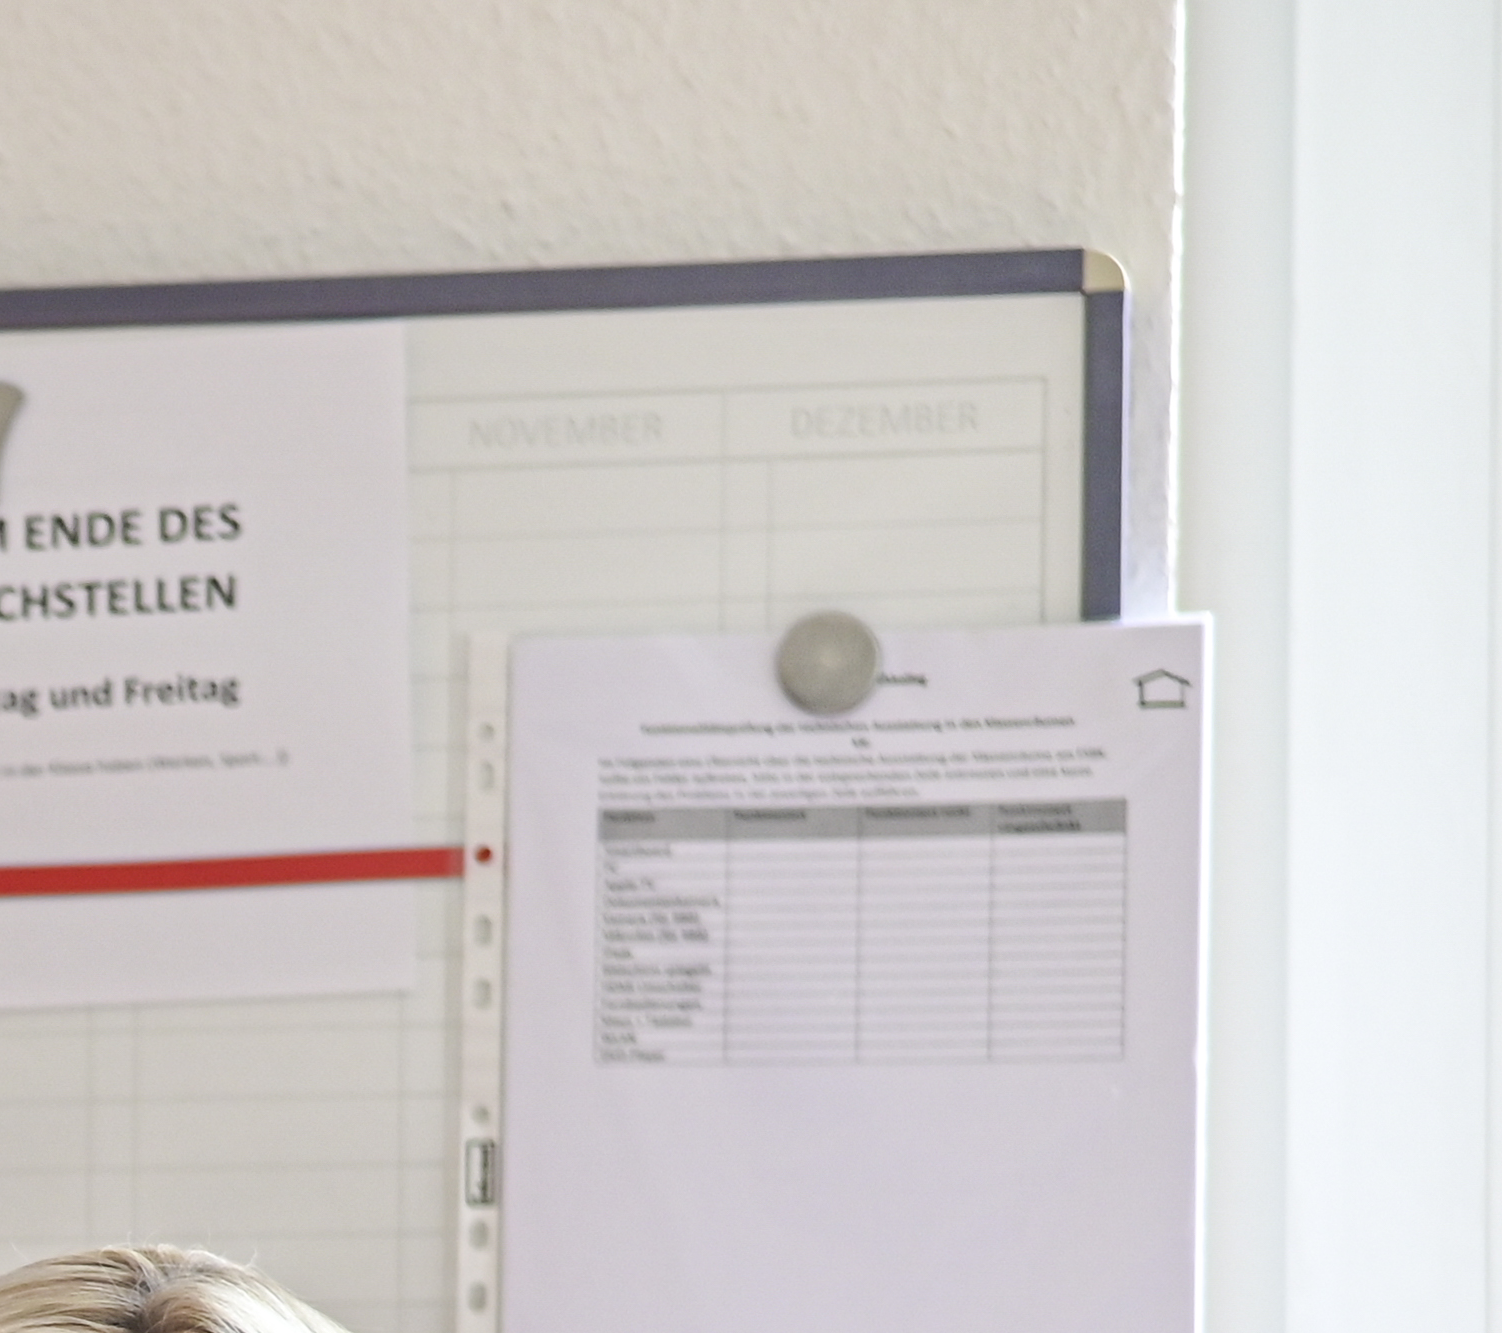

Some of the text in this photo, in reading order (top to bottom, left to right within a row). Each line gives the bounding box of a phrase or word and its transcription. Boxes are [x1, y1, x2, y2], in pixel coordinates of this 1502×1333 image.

[468, 411, 663, 450] NOVEMBER
[791, 401, 979, 440] DEZEMBER
[24, 509, 142, 552] ENDE
[157, 502, 242, 544] DES
[51, 676, 113, 710] und
[124, 672, 240, 706] Freitag
